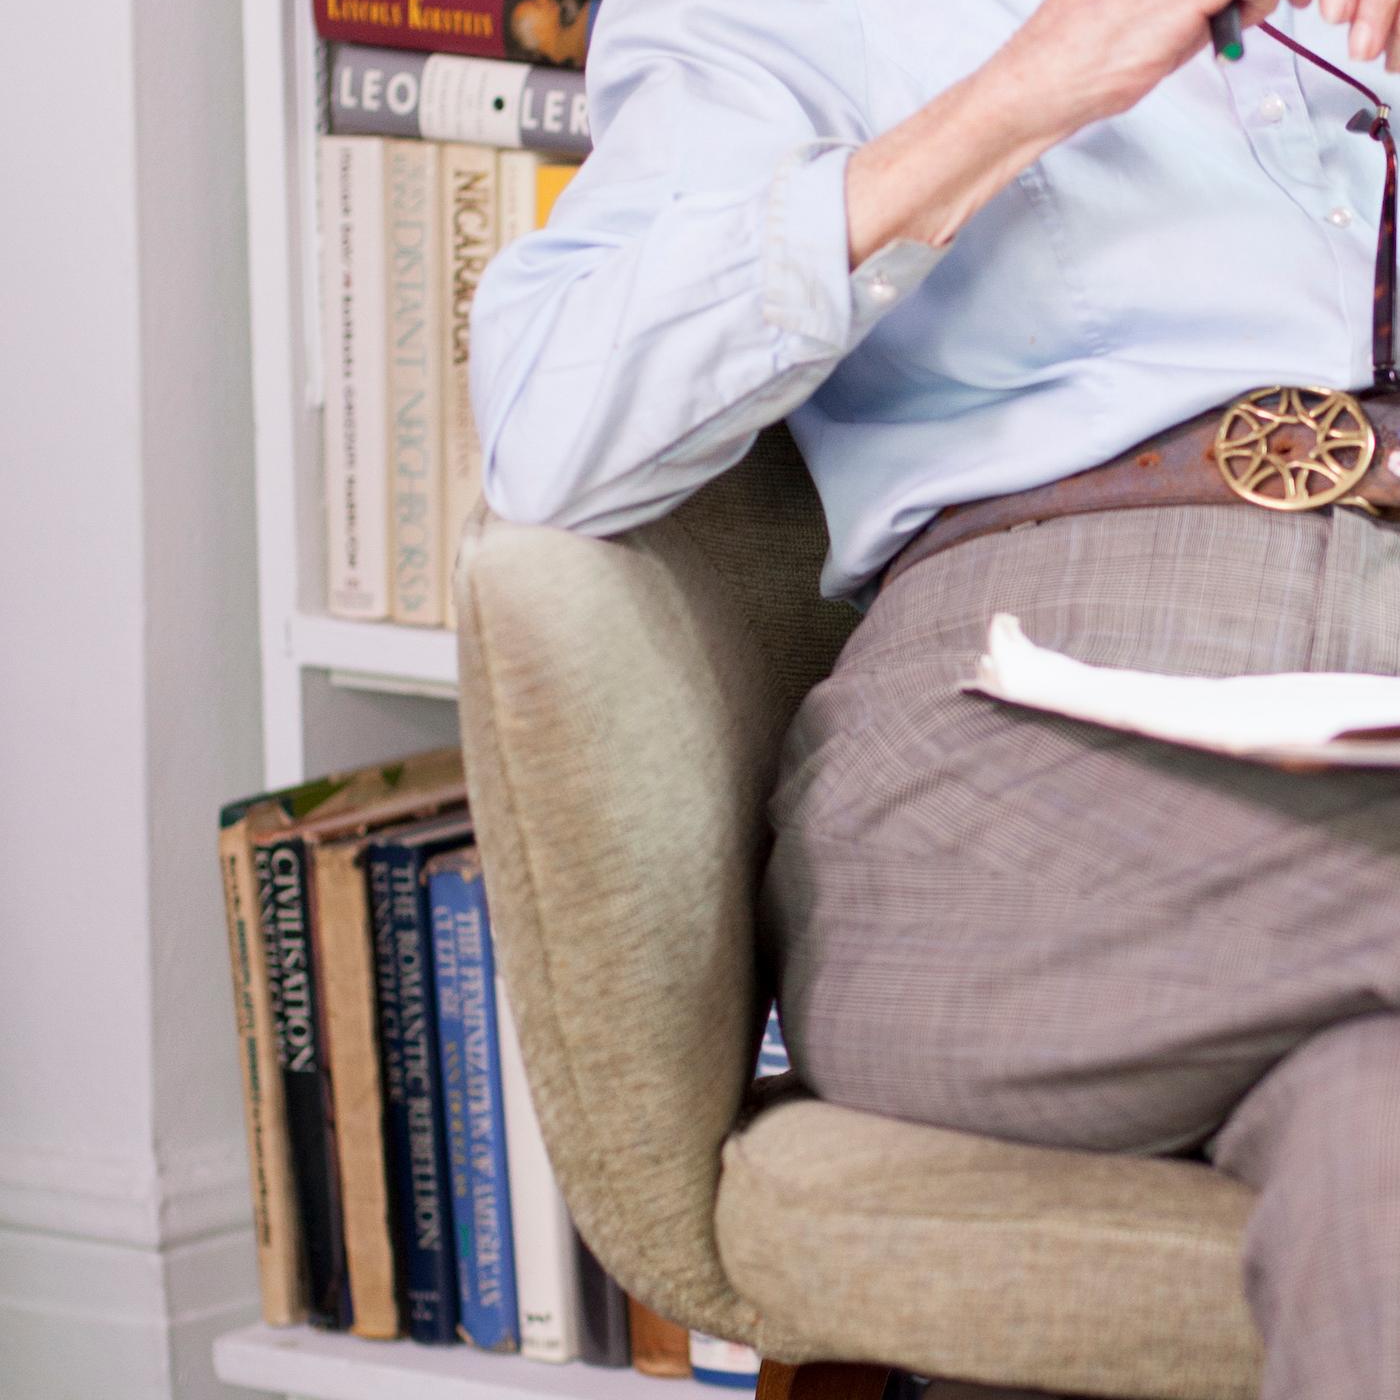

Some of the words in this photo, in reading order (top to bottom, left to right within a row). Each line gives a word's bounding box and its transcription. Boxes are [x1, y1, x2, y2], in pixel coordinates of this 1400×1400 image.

[339, 65, 419, 116] LEO
[520, 88, 592, 137] LER
[269, 847, 318, 1072] CIVILISATION
[395, 931, 430, 1087] ROMANTIC
